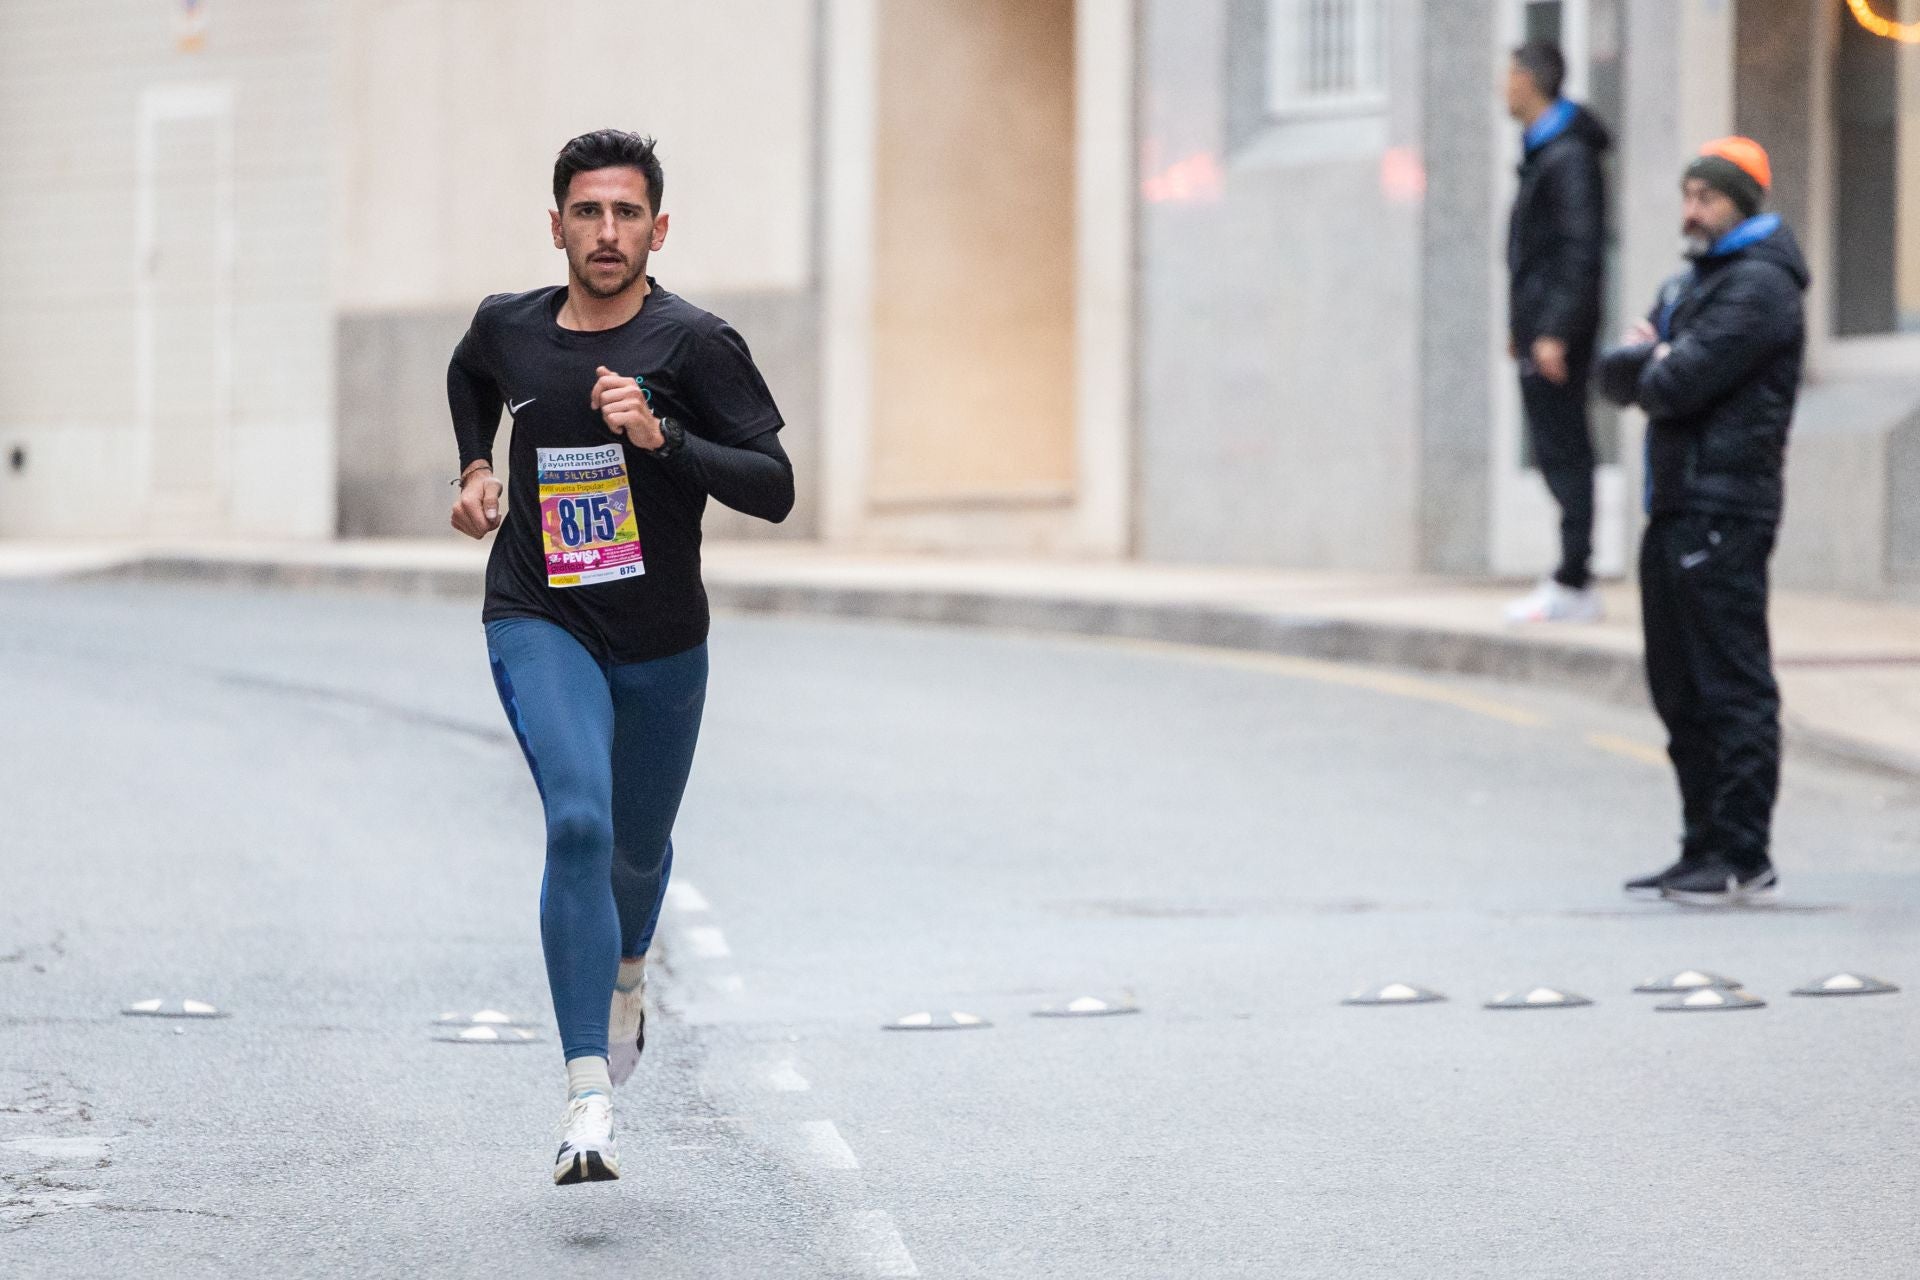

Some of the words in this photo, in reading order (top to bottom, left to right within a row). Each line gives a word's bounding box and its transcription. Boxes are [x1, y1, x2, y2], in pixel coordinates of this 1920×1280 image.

[549, 449, 616, 462] LARDERO
[547, 456, 620, 469] ayuntamiento
[558, 496, 616, 547] 875
[563, 550, 600, 564] PEVISA
[620, 565, 636, 575] 875
